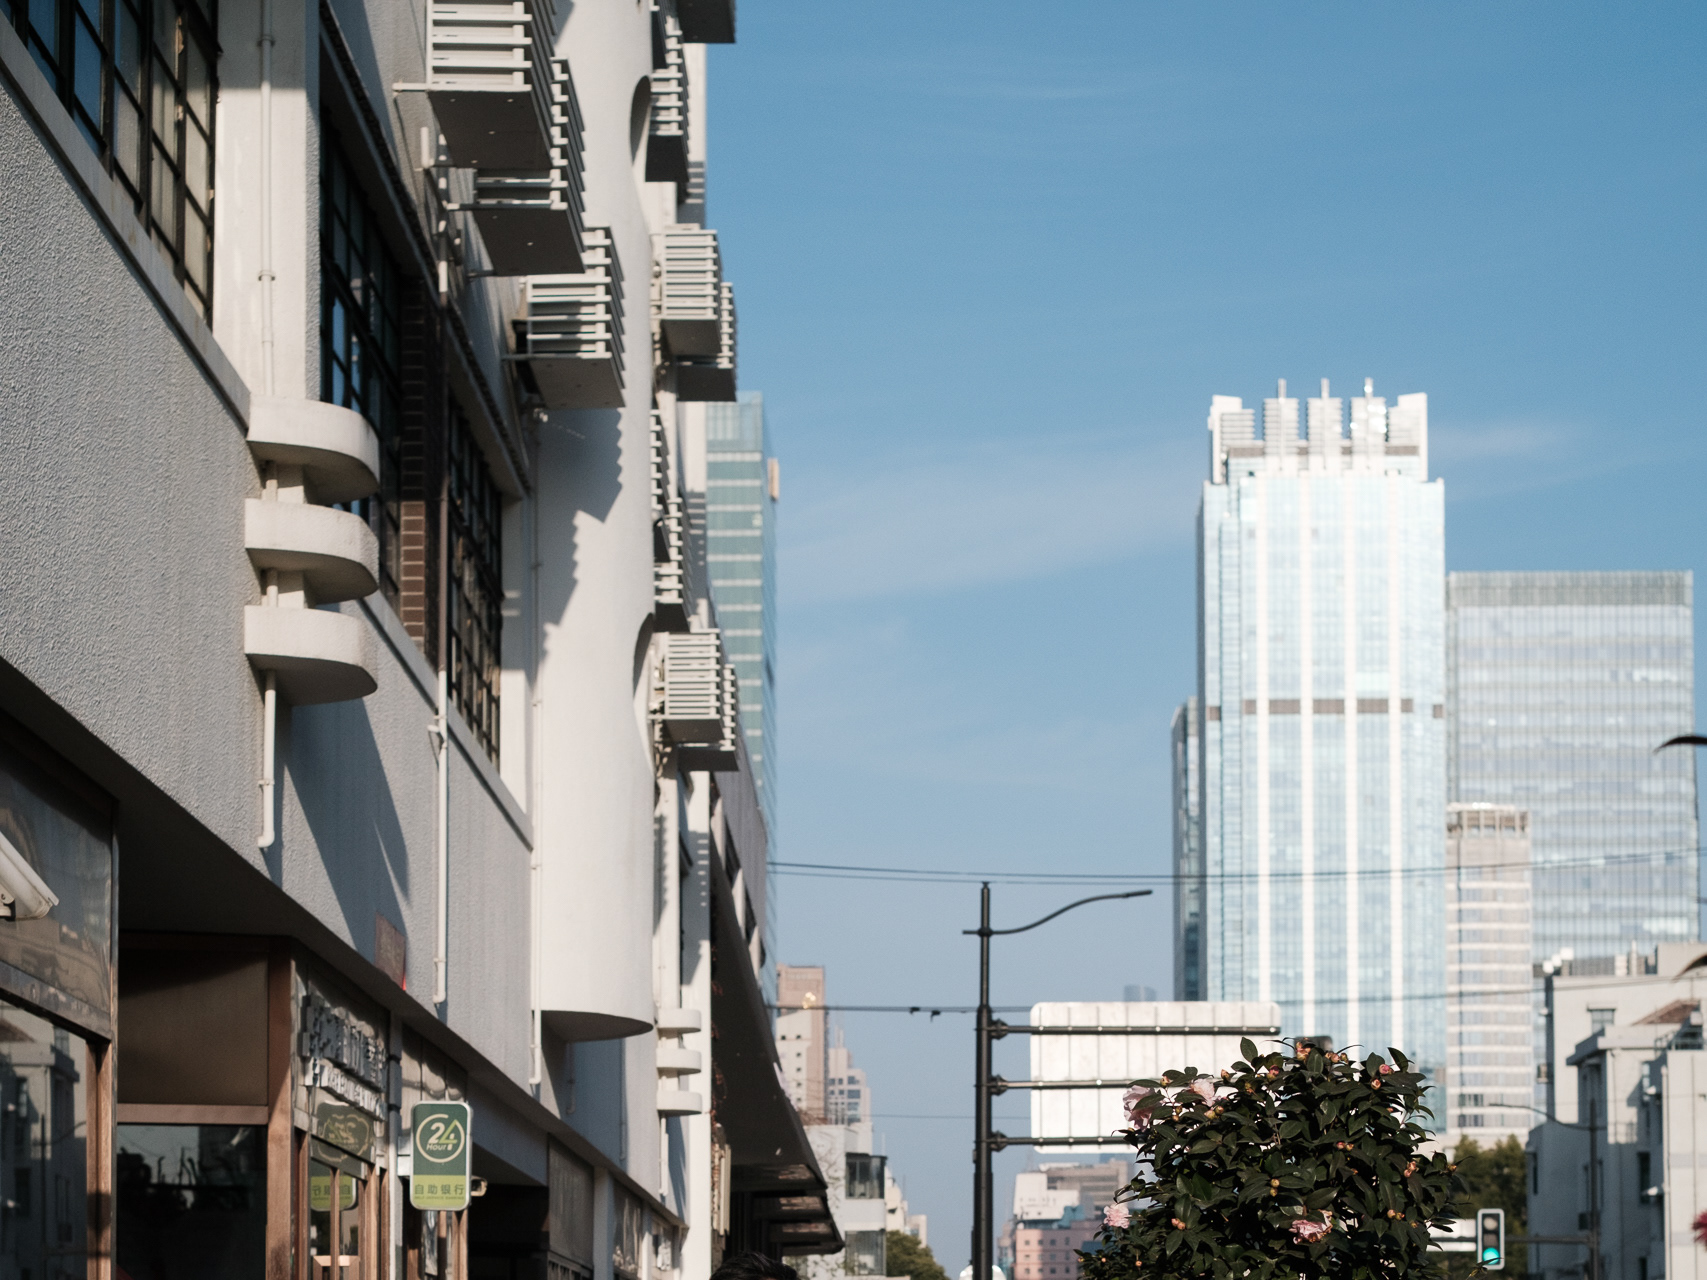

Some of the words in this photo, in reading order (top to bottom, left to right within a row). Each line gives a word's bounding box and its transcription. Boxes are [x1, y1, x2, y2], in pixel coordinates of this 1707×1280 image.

[428, 1119, 458, 1150] 24
[426, 1143, 447, 1151] Hour
[414, 1184, 465, 1196] 自助银行
